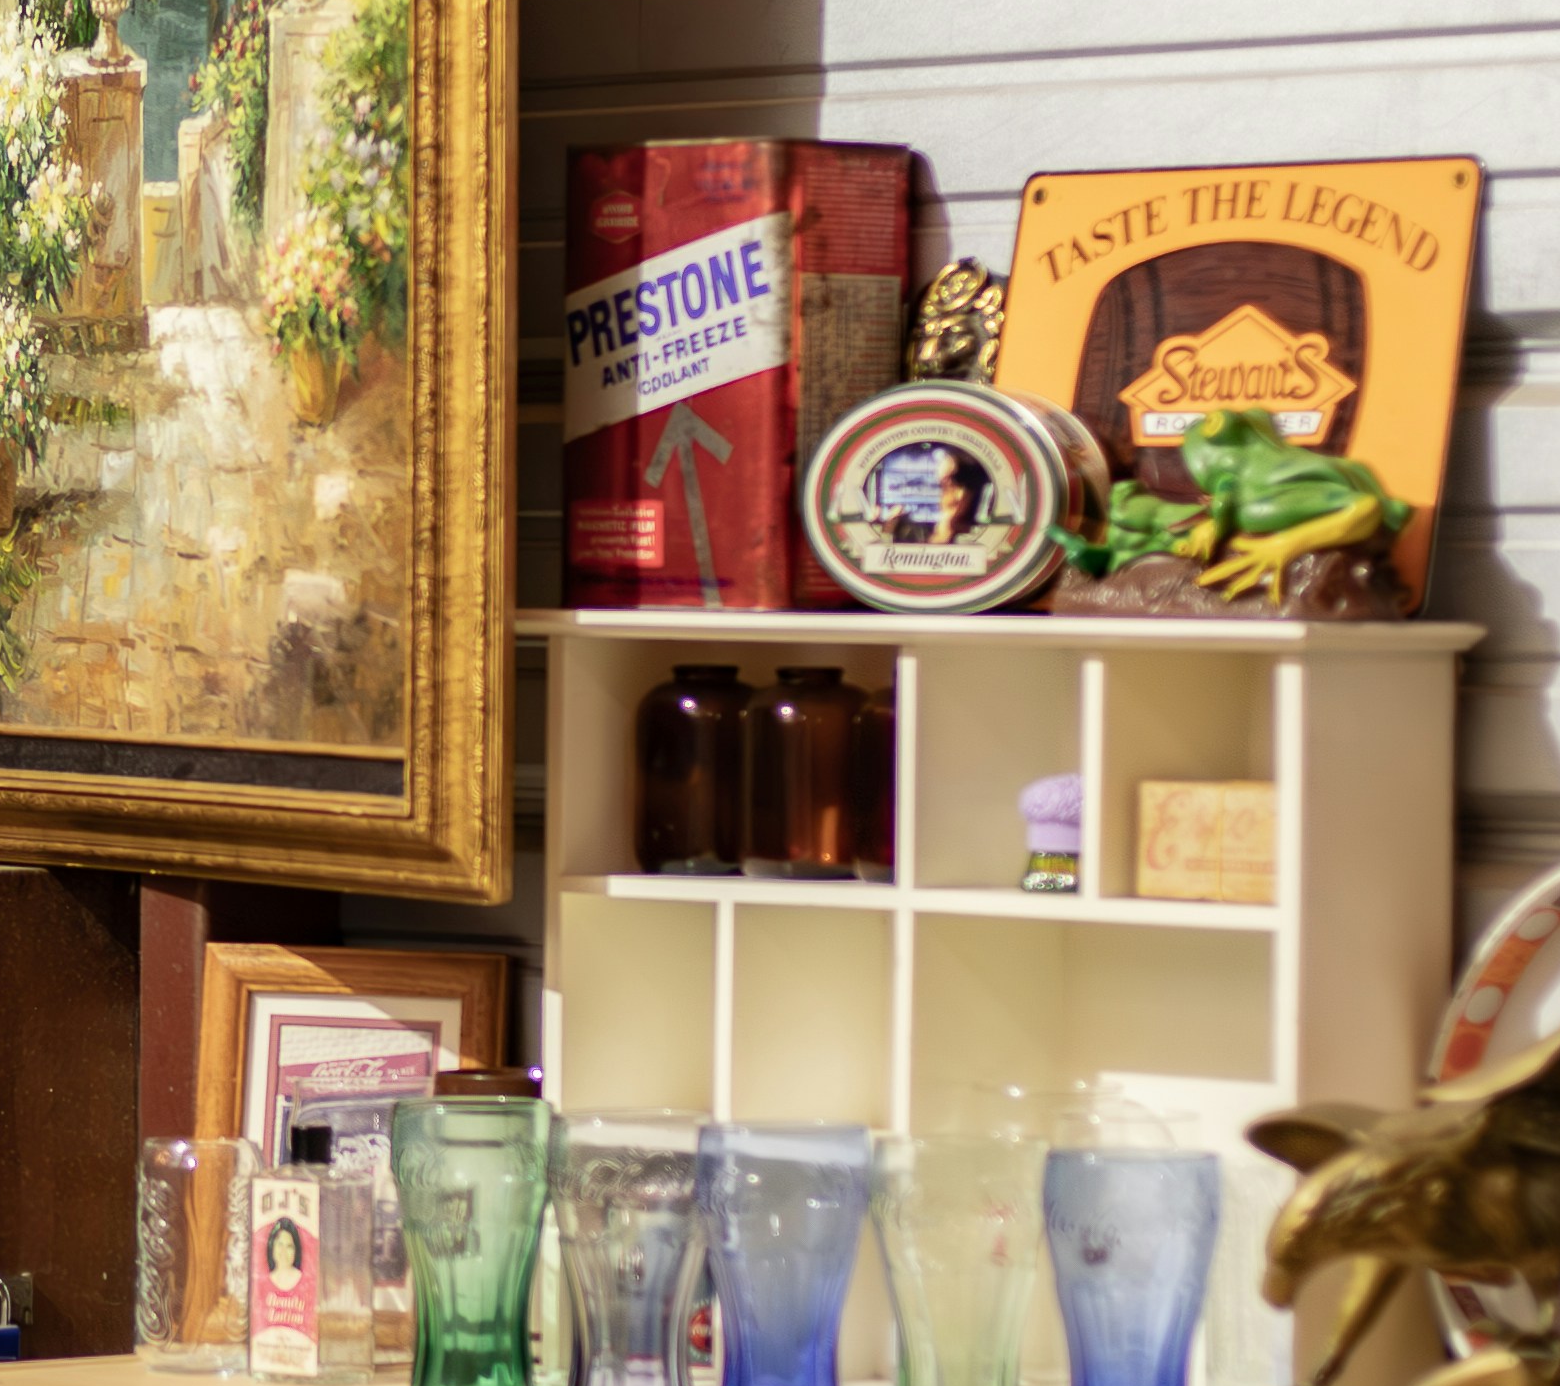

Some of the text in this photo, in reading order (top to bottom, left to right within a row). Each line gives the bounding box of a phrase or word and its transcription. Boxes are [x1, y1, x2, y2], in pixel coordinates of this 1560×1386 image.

[1038, 179, 1439, 284] TASTE THE LEGEND
[567, 239, 771, 368] PRESTONE
[601, 315, 748, 389] ANTI-FREEZE
[637, 356, 712, 397] COOLANT
[879, 546, 970, 570] Remington
